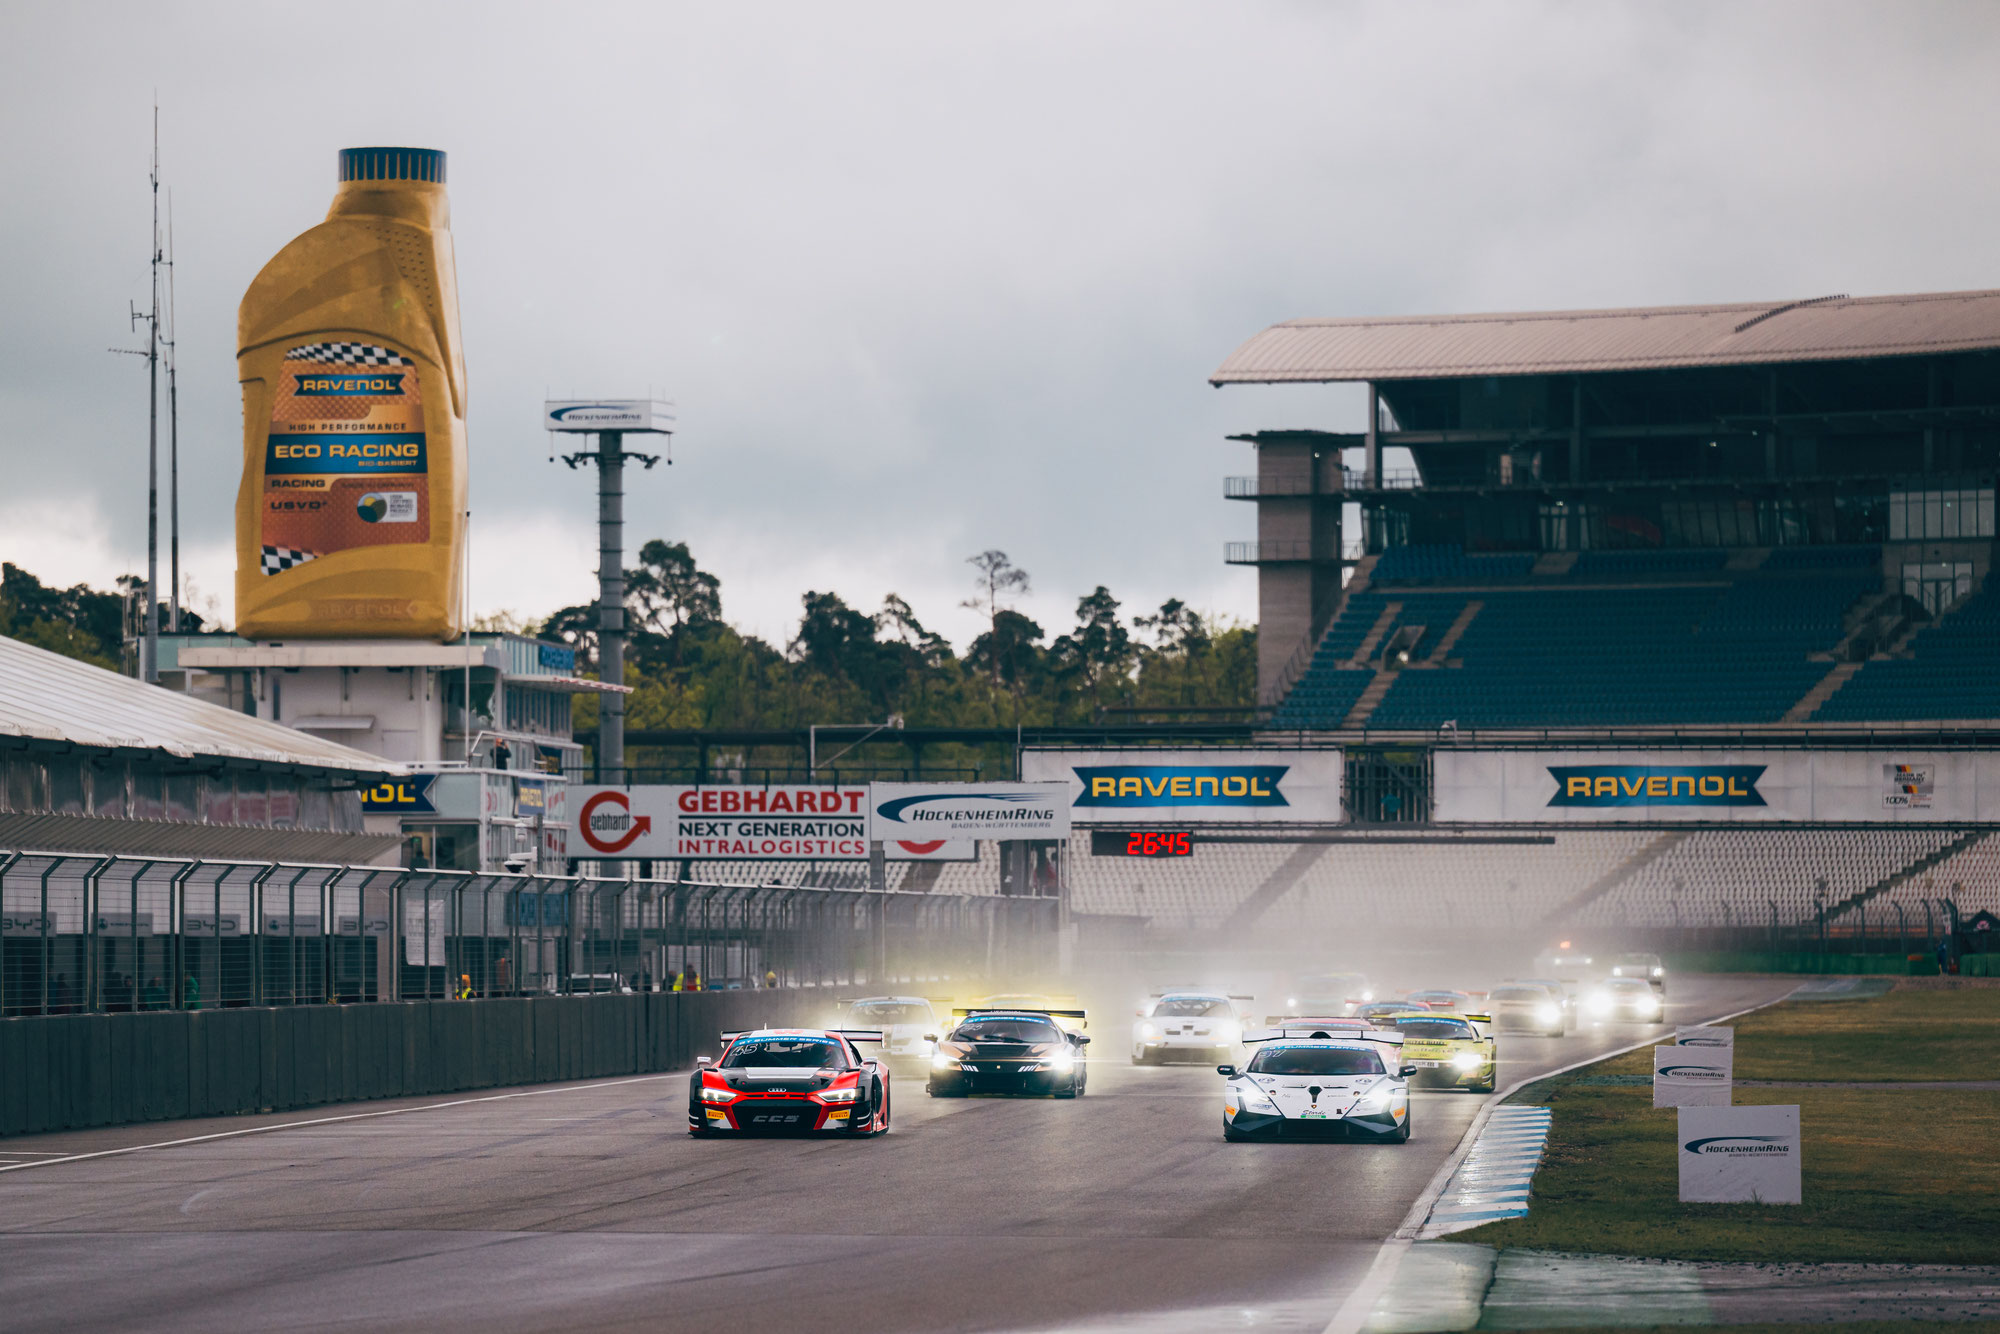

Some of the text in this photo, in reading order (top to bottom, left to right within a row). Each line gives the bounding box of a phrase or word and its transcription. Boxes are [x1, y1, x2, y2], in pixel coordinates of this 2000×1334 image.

[303, 379, 396, 391] RAVENOL
[289, 422, 407, 432] HIGH PERFORMANCE
[275, 443, 419, 459] ECO RACING
[271, 479, 326, 488] RACING
[362, 784, 416, 803] OL
[1091, 776, 1271, 798] RAVENOL
[1567, 775, 1748, 797] RAVENOL
[678, 790, 864, 813] GEBHARDT
[1885, 796, 1909, 805] 100%
[591, 813, 630, 830] gebhardt
[678, 822, 864, 837] NEXT GENERATION
[678, 839, 865, 855] INTRALOGISTICS
[186, 919, 236, 931] BYD
[799, 1037, 836, 1045] SERIES
